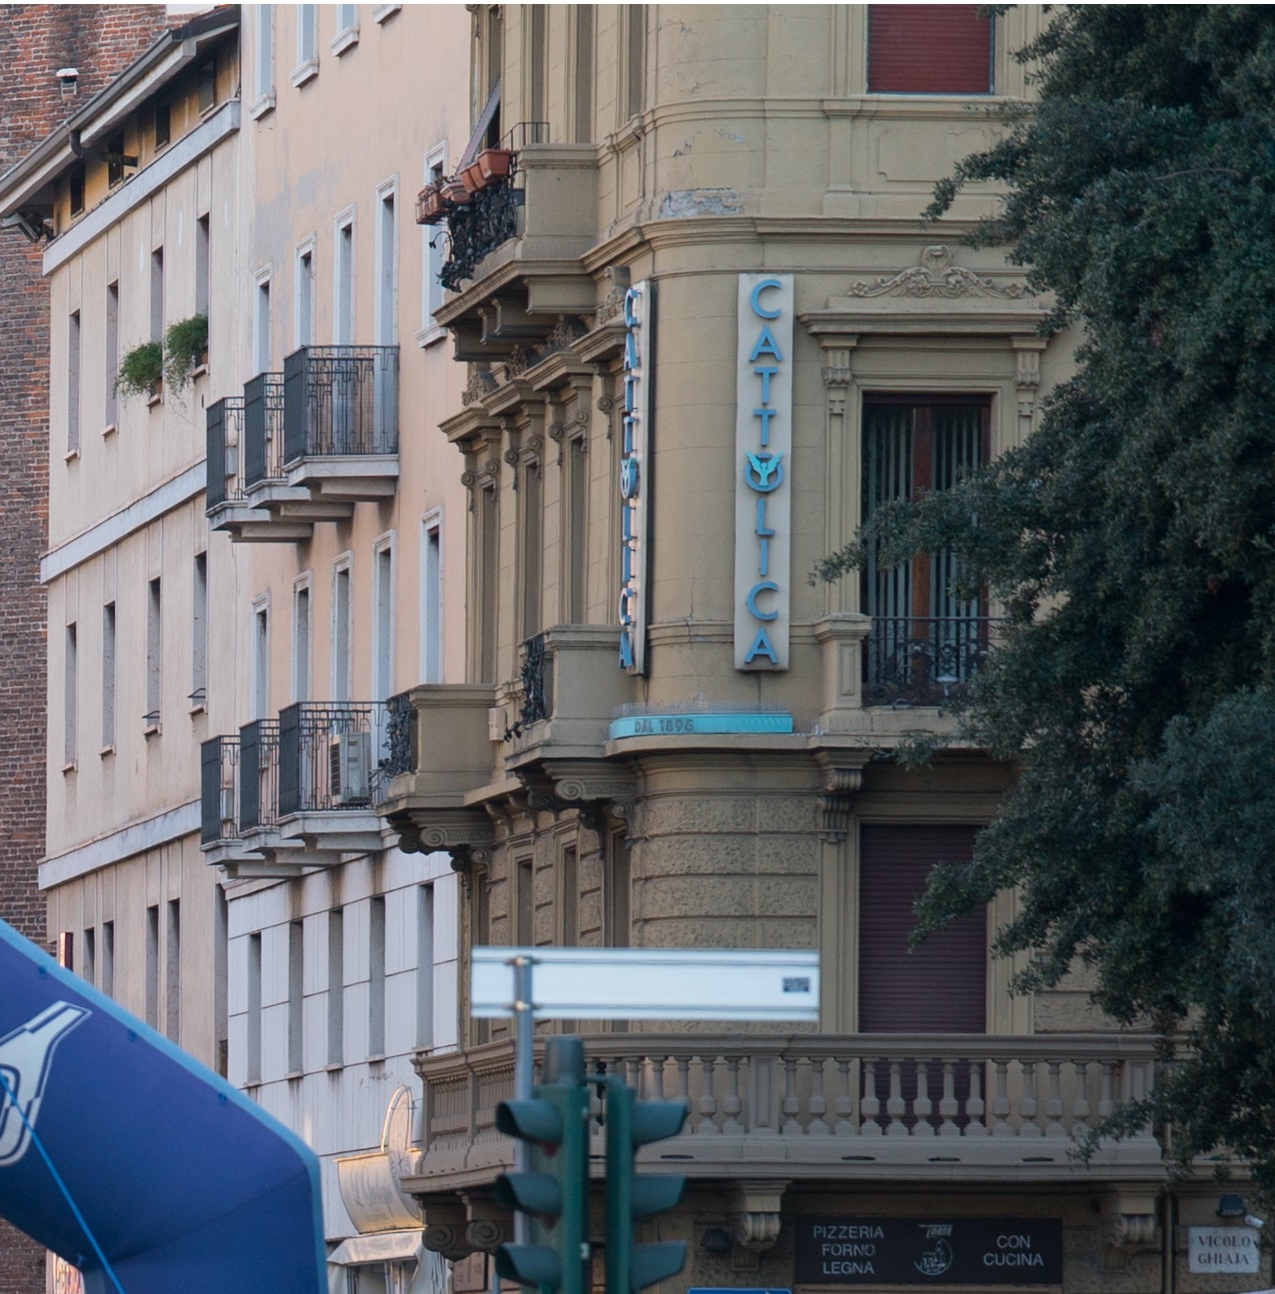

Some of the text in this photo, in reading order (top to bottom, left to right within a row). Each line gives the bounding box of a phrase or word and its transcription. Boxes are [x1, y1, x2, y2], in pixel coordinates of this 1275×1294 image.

[744, 278, 784, 665] CATTOLICA
[618, 287, 639, 670] CATTOLICA
[634, 719, 694, 733] DAL 1896
[813, 1226, 884, 1239] PIZZERIA
[996, 1235, 1031, 1249] CON
[1198, 1235, 1251, 1248] VICOLO
[822, 1243, 875, 1256] FORNO
[983, 1253, 1044, 1266] CUCINA
[1198, 1252, 1249, 1265] GHIAJA
[823, 1262, 875, 1274] LEGNA
